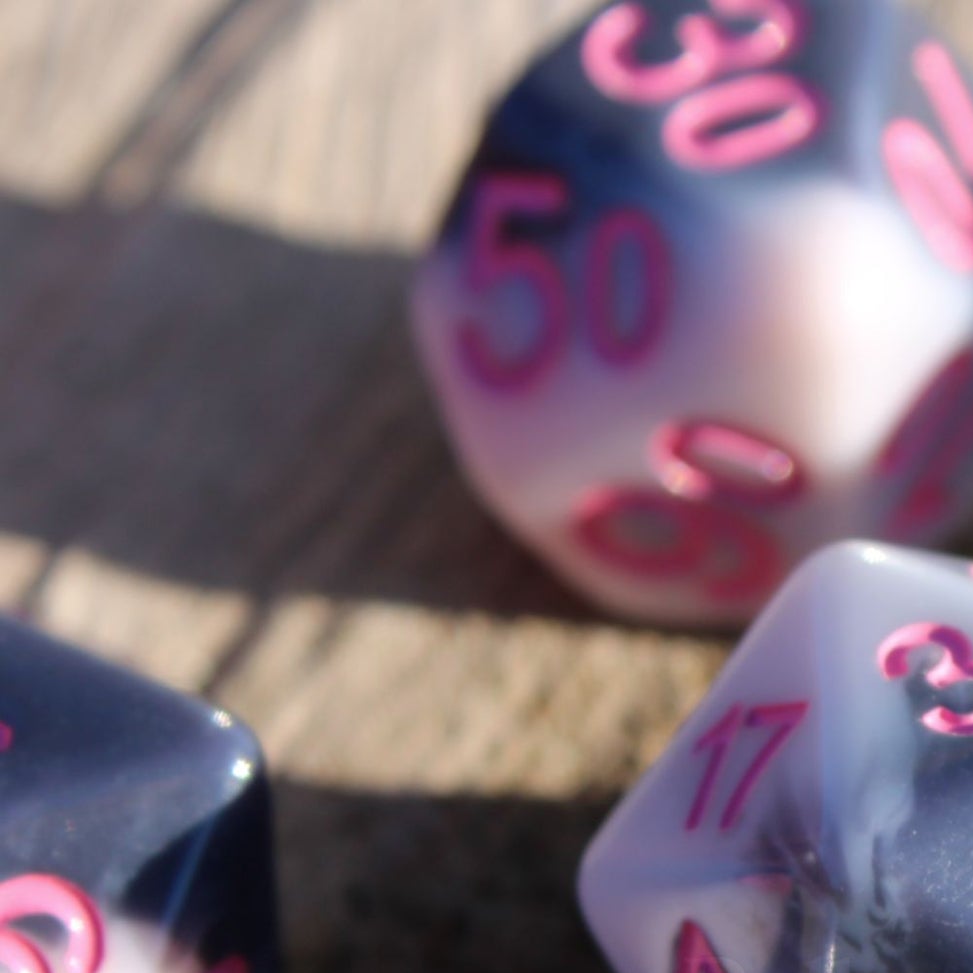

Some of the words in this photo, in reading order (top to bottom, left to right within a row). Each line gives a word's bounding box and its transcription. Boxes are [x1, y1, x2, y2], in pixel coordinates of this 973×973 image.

[582, 0, 814, 172] 30
[455, 176, 672, 402] 50
[683, 700, 810, 833] 17
